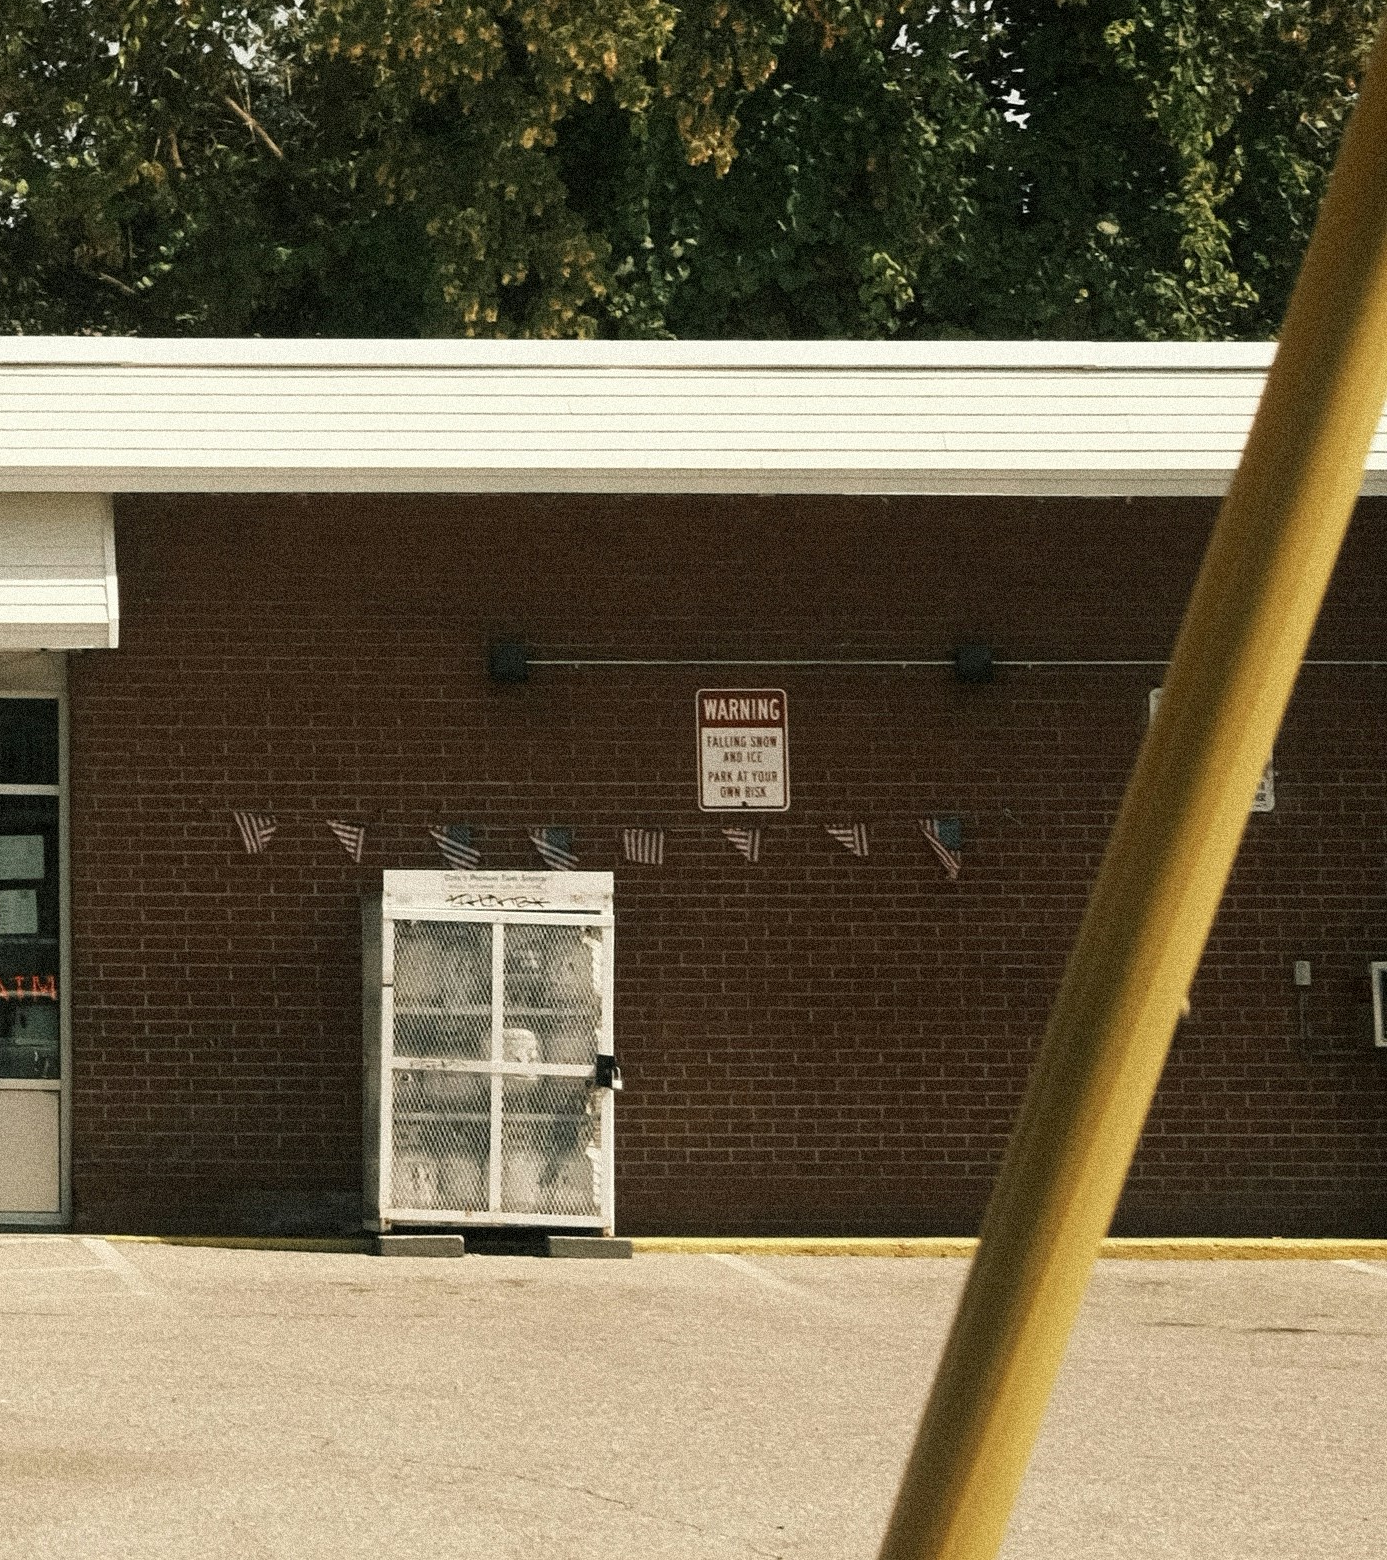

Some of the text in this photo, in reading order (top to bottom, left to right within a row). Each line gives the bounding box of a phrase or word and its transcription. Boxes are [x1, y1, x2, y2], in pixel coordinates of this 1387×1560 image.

[703, 699, 781, 721] WARNING
[707, 736, 778, 748] FALLING SNOW
[723, 751, 763, 763] AND ICE
[708, 771, 778, 782] PARK AT YOUR
[720, 786, 767, 798] OWN RISK
